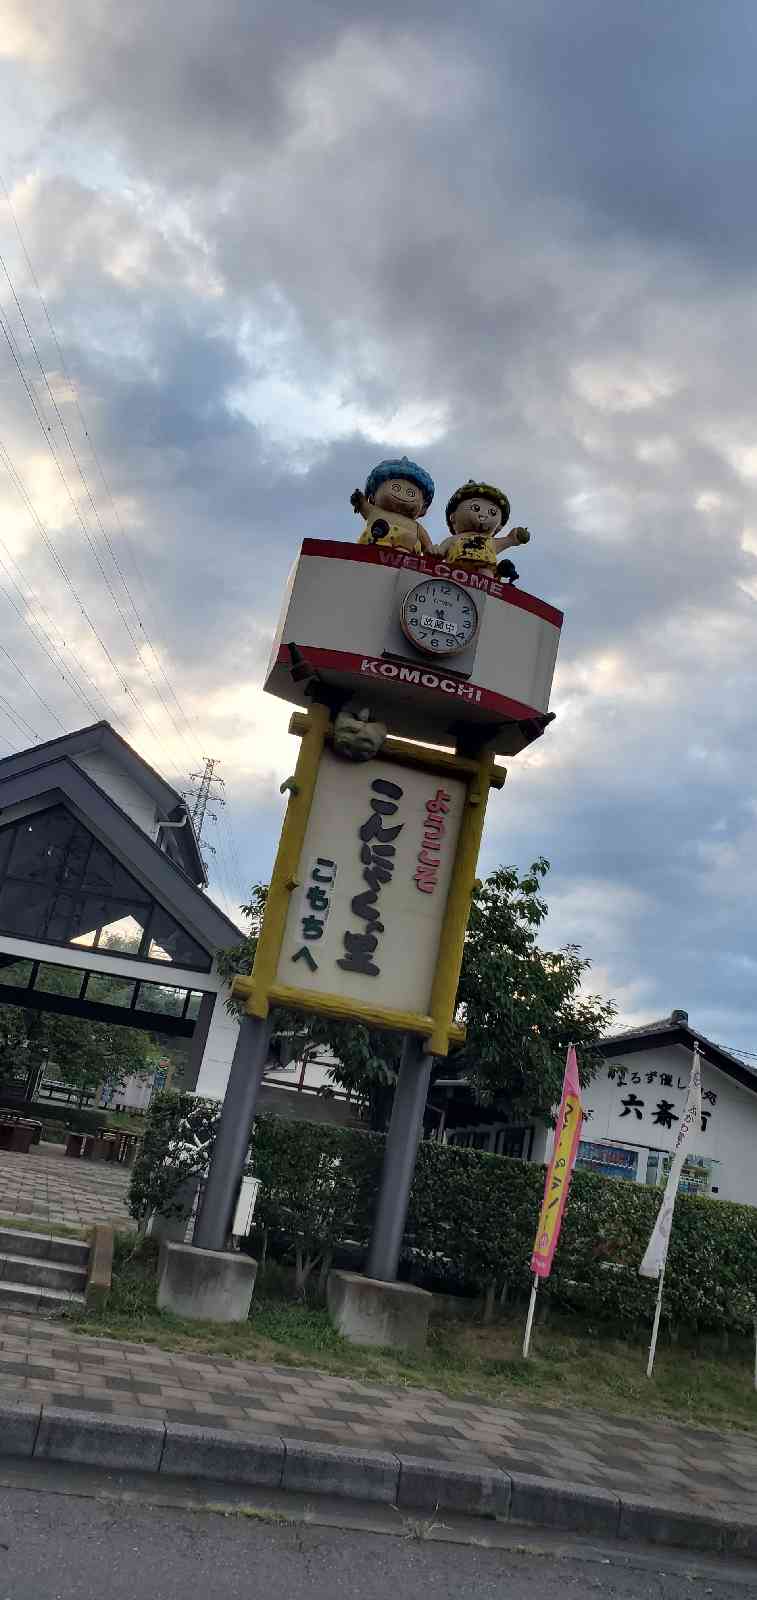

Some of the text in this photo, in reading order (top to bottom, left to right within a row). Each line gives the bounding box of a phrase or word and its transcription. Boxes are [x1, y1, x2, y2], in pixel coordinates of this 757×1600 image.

[378, 549, 505, 597] WELCOME
[426, 585, 436, 596] 11
[440, 585, 451, 595] 12
[415, 593, 426, 603] 10
[456, 591, 462, 601] 1
[408, 604, 418, 613] 9
[462, 606, 471, 615] 2
[408, 617, 418, 627] 8
[463, 620, 471, 629] 3
[418, 631, 427, 640] 7
[456, 632, 465, 640] 4
[430, 638, 439, 647] 6
[445, 638, 454, 647] 5
[360, 659, 482, 703] KOMOCHI
[415, 788, 451, 895] ようこそ
[292, 857, 335, 973] こもちへ
